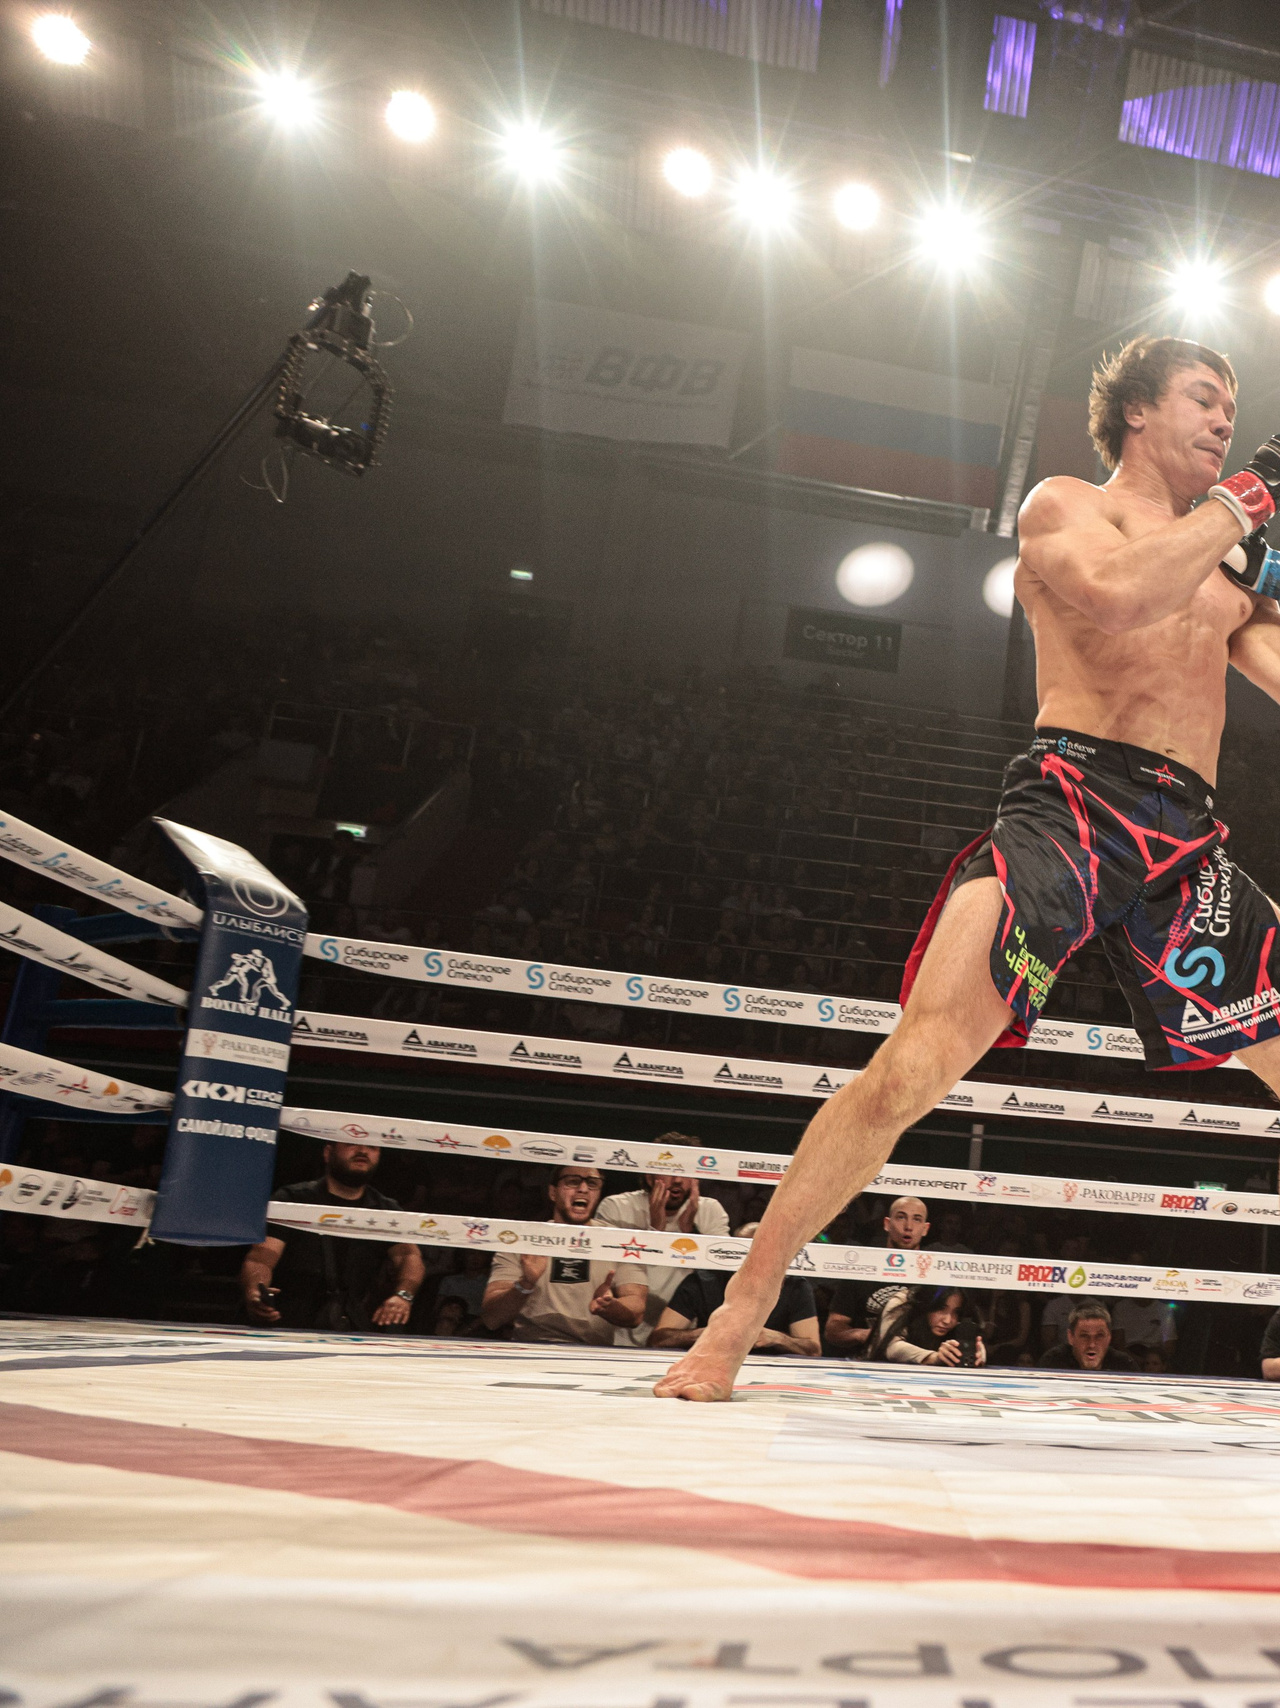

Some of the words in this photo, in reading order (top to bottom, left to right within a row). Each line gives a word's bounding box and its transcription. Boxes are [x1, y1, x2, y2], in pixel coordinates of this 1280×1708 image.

[344, 945, 409, 963] Сибирское
[343, 956, 390, 970] Стекло
[448, 959, 511, 976] Сибирское
[446, 968, 493, 983] Стекло
[549, 971, 612, 987] Сибирское
[548, 981, 594, 995] Стекло
[648, 982, 709, 999] Сибирское
[647, 991, 691, 1006] Стекло
[745, 994, 804, 1009] Сибирское
[201, 996, 257, 1017] BOXING
[259, 1002, 292, 1024] HALL
[744, 1003, 787, 1017] Стекло
[839, 1004, 896, 1019] Сибирское
[837, 1013, 880, 1027] Стекло
[317, 1027, 369, 1041] АВАНГАРД
[1183, 1020, 1243, 1045] СТРОИТЕЛЬНАЯ
[427, 1040, 477, 1052] АВАНГАРД
[534, 1051, 582, 1063] АВАНГАРД
[637, 1062, 684, 1074] АВАНГАРД
[736, 1072, 783, 1084] АВАНГАРД
[883, 1177, 967, 1191] FIGHTEXPERT
[1083, 1187, 1155, 1203] РАКОВАРНЯ
[1160, 1193, 1210, 1211] BROZEX
[937, 1260, 1013, 1275] РАКОВАРНЯ
[1017, 1264, 1067, 1283] BROZEX
[1087, 1280, 1138, 1289] ДЕНЬГАМИ
[1088, 1272, 1152, 1284] ЗАПРАВЛЯЕМ
